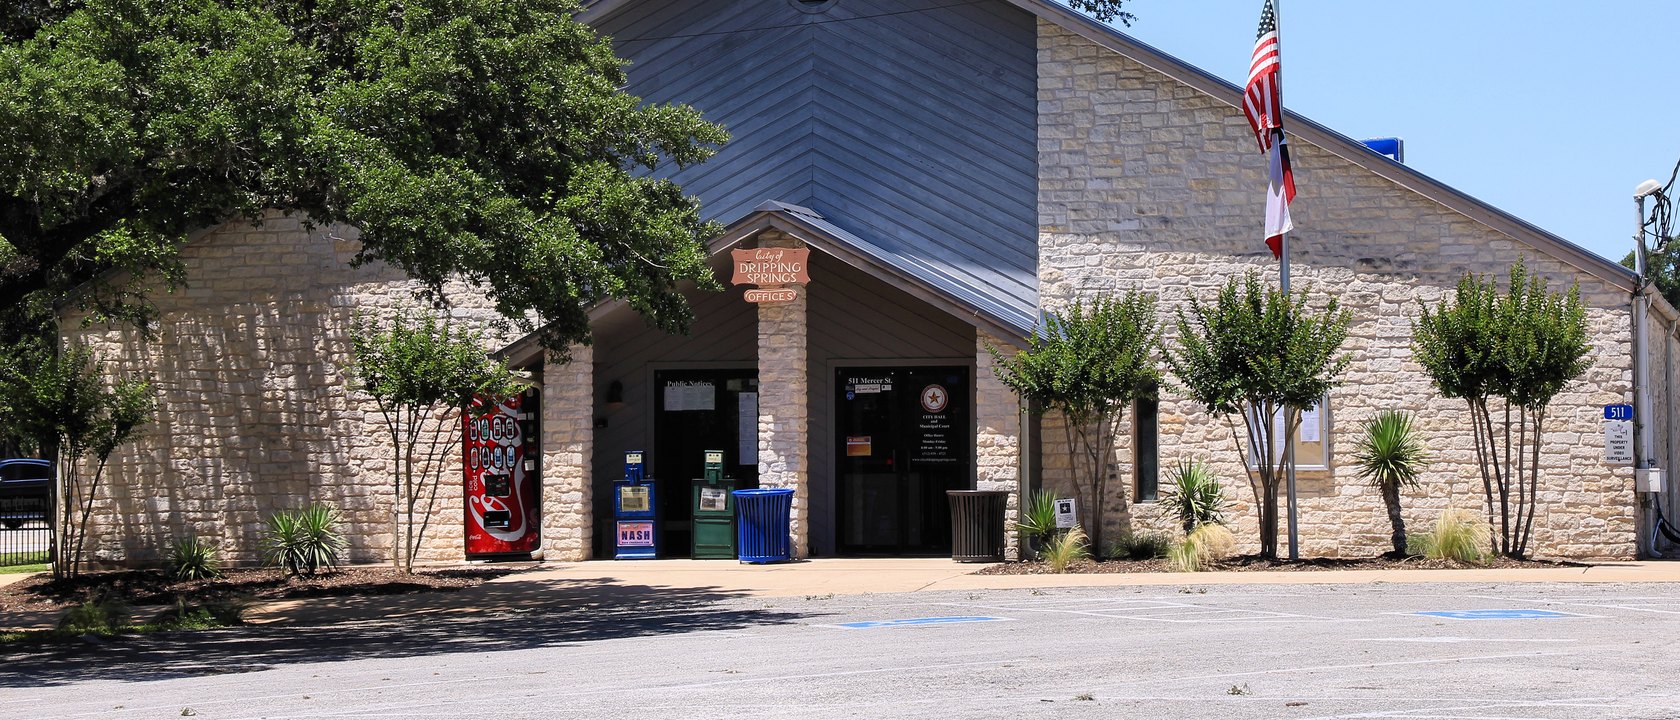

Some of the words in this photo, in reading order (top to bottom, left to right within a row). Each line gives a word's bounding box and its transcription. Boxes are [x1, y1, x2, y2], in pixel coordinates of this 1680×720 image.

[756, 250, 774, 262] City
[775, 250, 784, 262] of
[740, 262, 801, 273] DRIPPING
[747, 273, 797, 283] SPRINGS
[1611, 407, 1624, 417] 511
[622, 531, 650, 540] NASH
